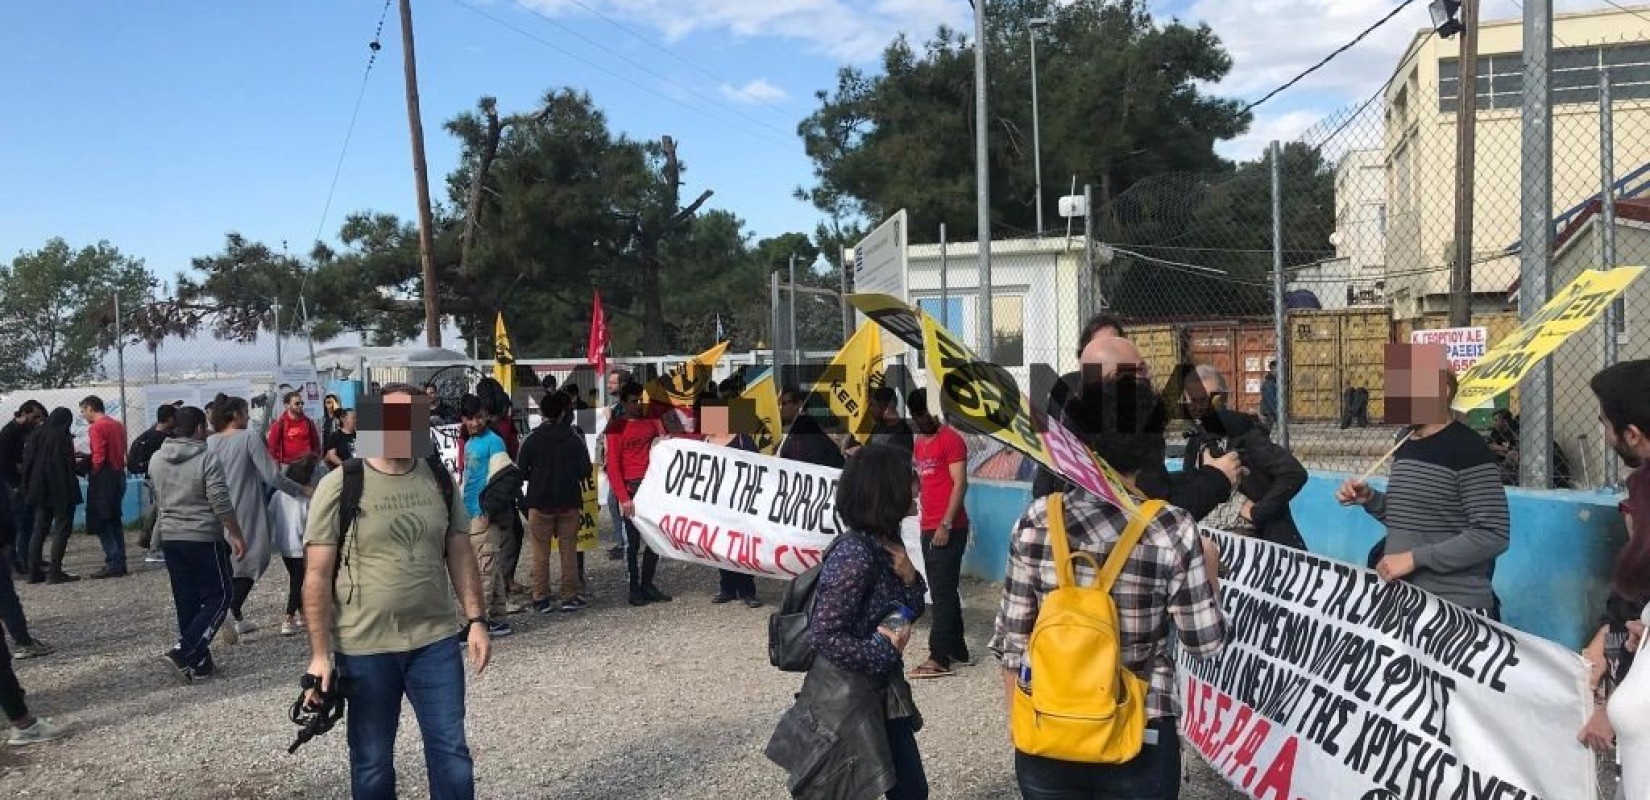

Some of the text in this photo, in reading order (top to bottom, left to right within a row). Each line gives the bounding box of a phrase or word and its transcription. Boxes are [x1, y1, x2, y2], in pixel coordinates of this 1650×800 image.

[830, 378, 860, 419] ΚΕΕ
[665, 449, 727, 505] OPEN
[729, 461, 768, 515] THE
[658, 514, 823, 577] OPEN THE CIT
[1243, 542, 1331, 608] ΚΛΕΙΣΤΕ
[1321, 563, 1357, 619] ΤΑ
[1347, 572, 1427, 647] ΣΥΝΟΡΑ
[1221, 647, 1242, 695] ΟΙ
[1296, 684, 1358, 757] ΤΗΣ
[1344, 711, 1458, 800] ΧΡΥΣΗΣ
